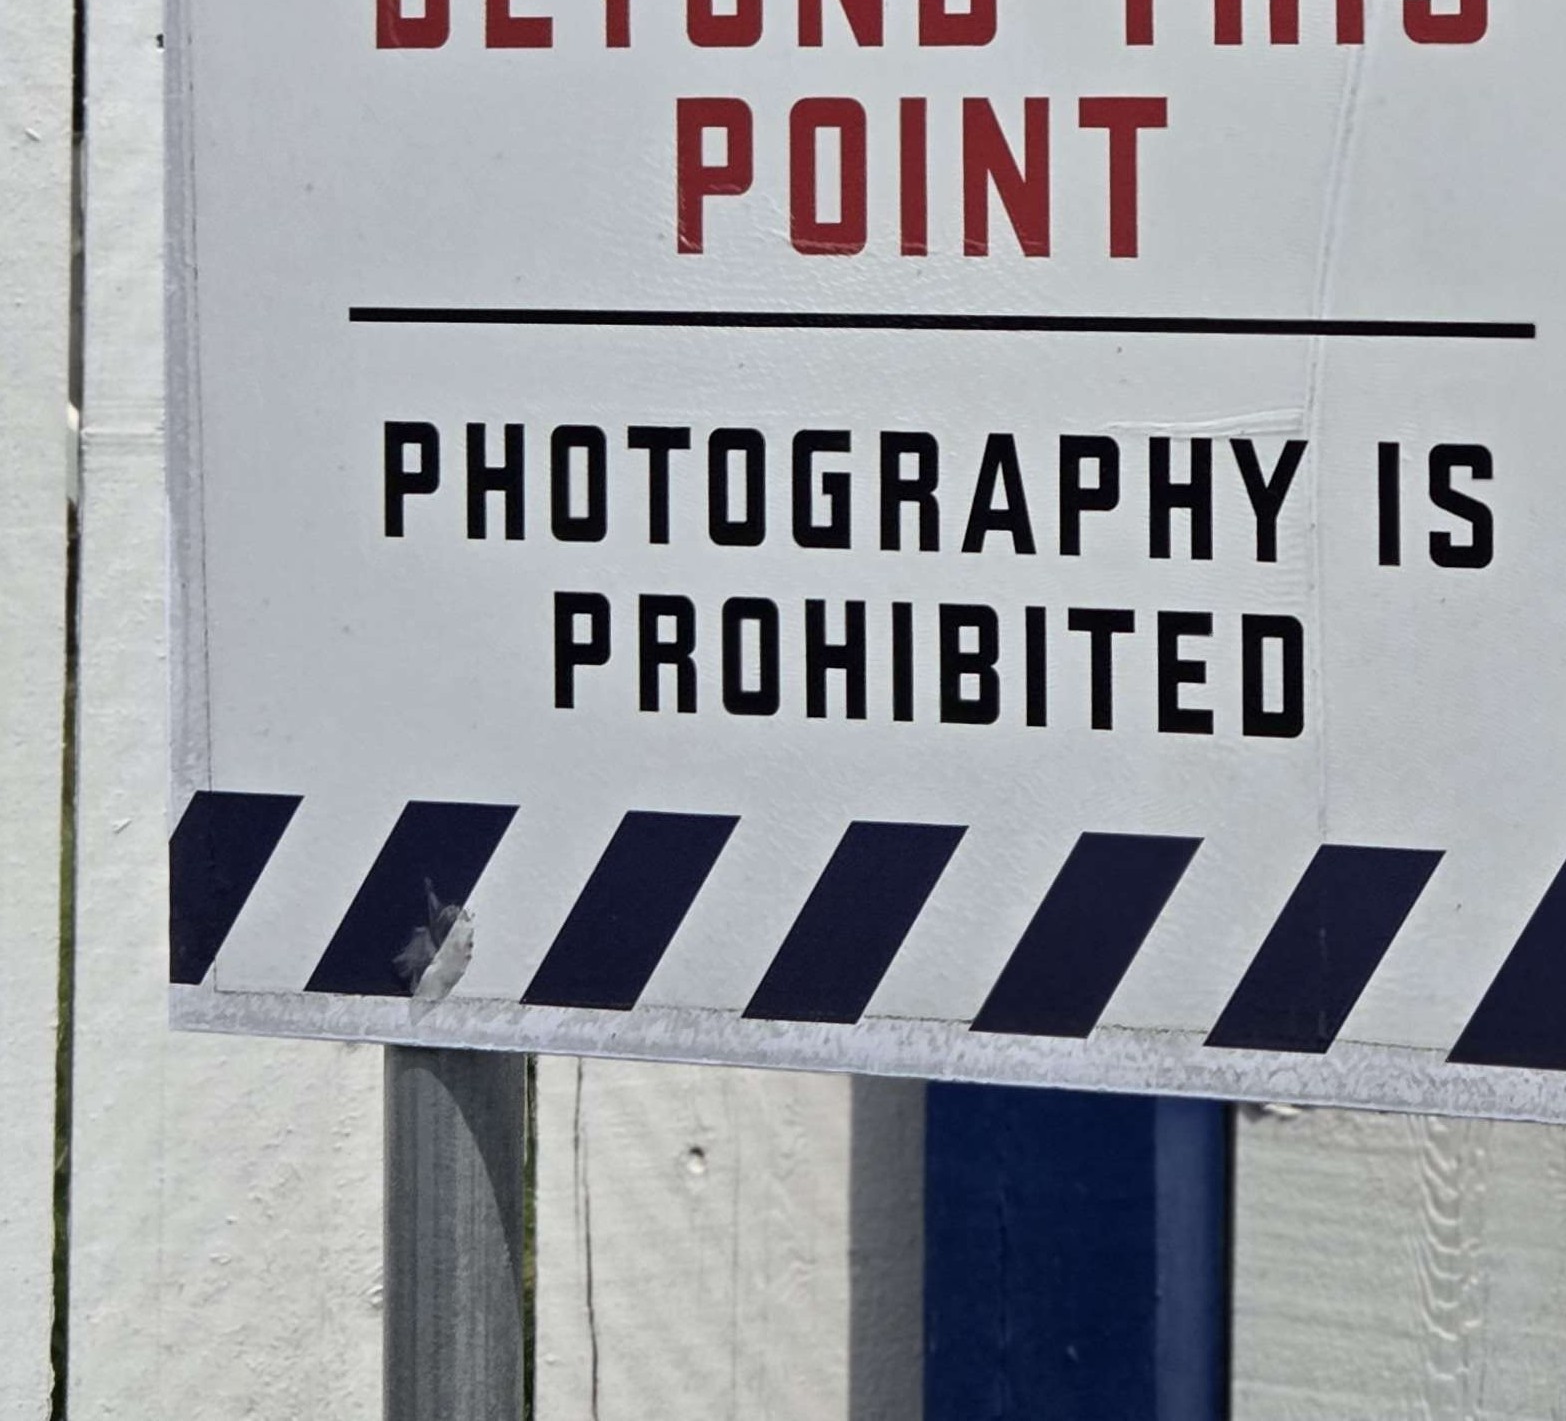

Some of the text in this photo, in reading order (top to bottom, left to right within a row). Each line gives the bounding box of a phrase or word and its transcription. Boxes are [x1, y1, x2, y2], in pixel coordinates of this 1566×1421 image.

[678, 98, 1166, 257] POINT
[385, 422, 1493, 568] PHOTOGRAPHY IS
[555, 592, 1303, 738] PROHIBITED
